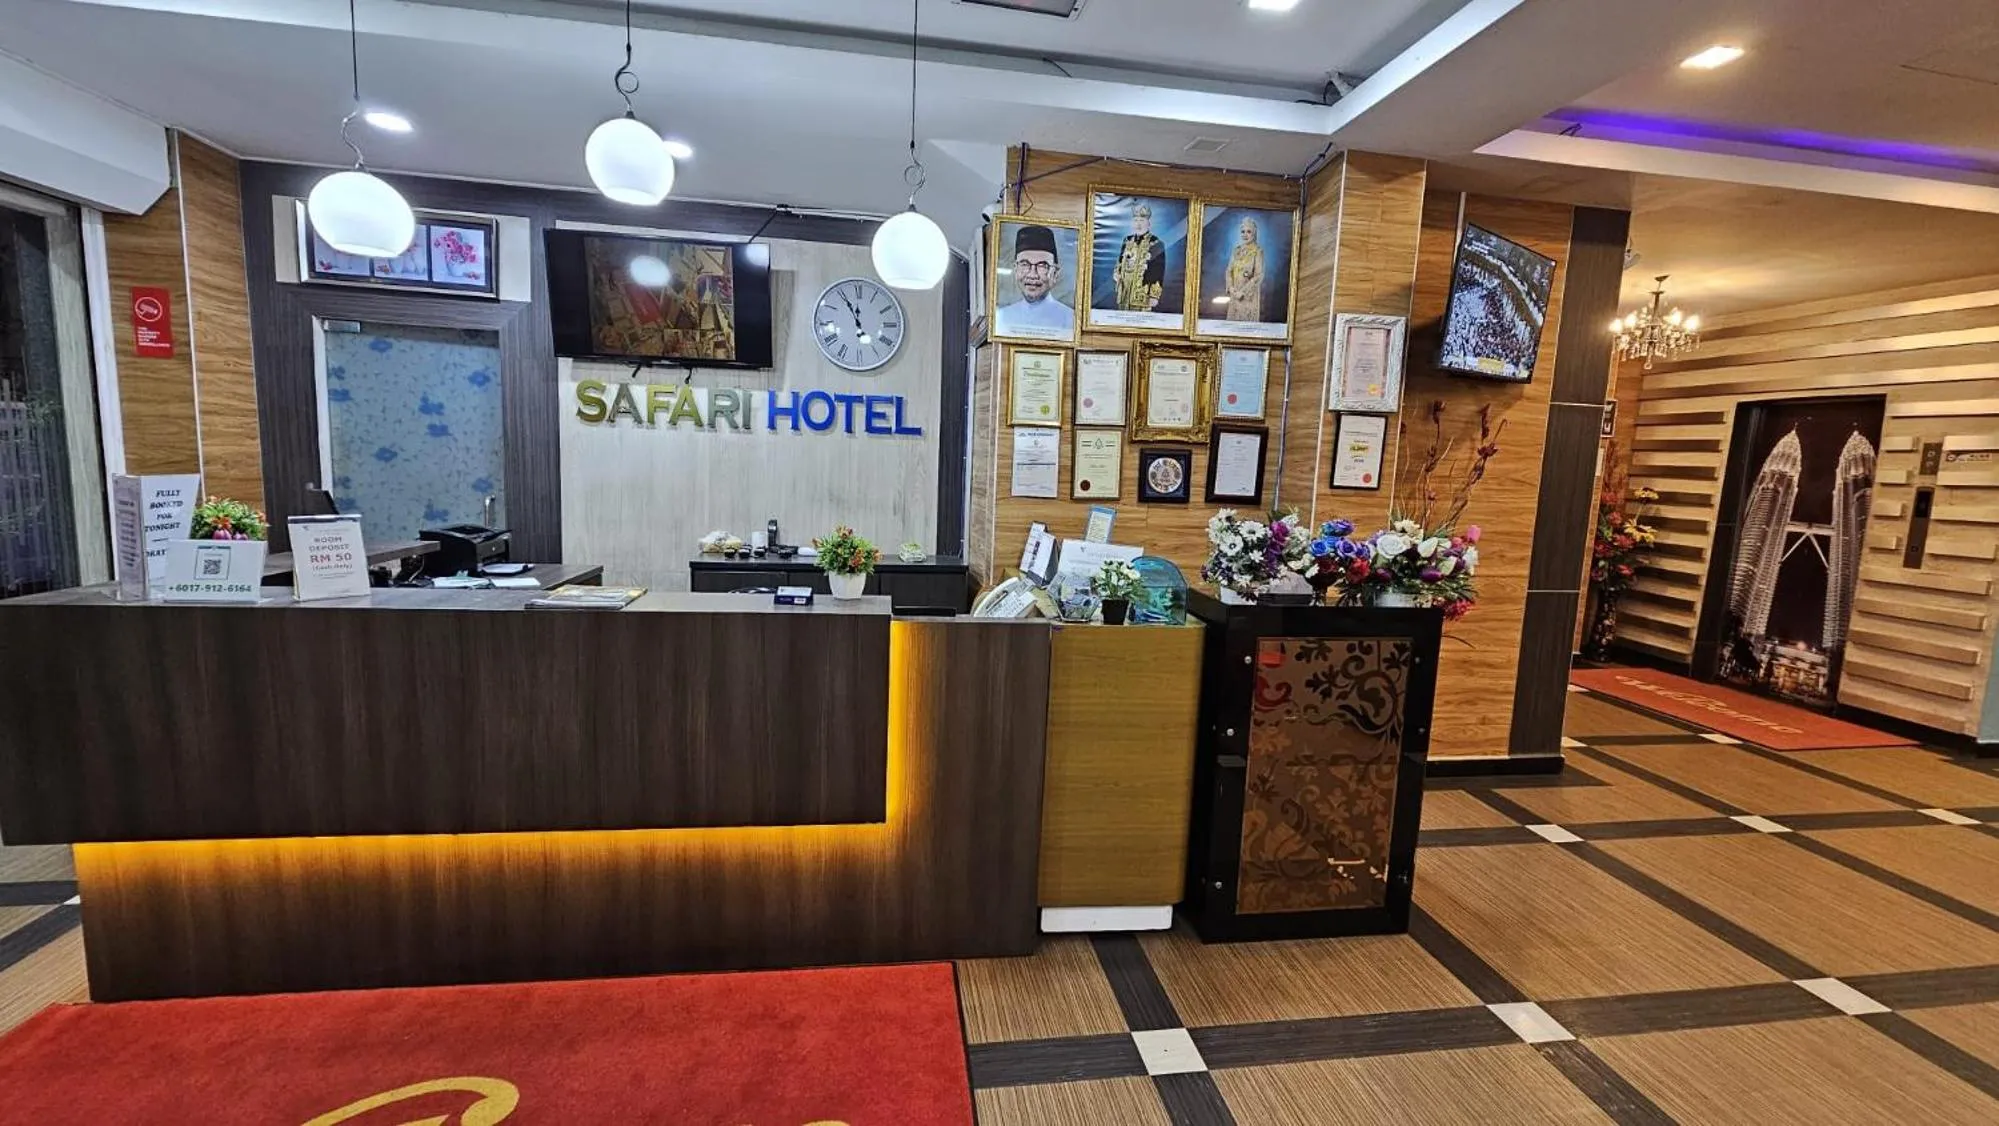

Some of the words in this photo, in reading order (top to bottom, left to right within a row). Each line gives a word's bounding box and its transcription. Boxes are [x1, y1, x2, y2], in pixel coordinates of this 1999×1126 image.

[575, 378, 752, 431] SAFARI
[768, 387, 922, 437] HOTEL
[155, 489, 181, 498] FULLY
[144, 522, 181, 532] TONIGHT
[310, 554, 330, 564] RM
[335, 552, 352, 562] 50
